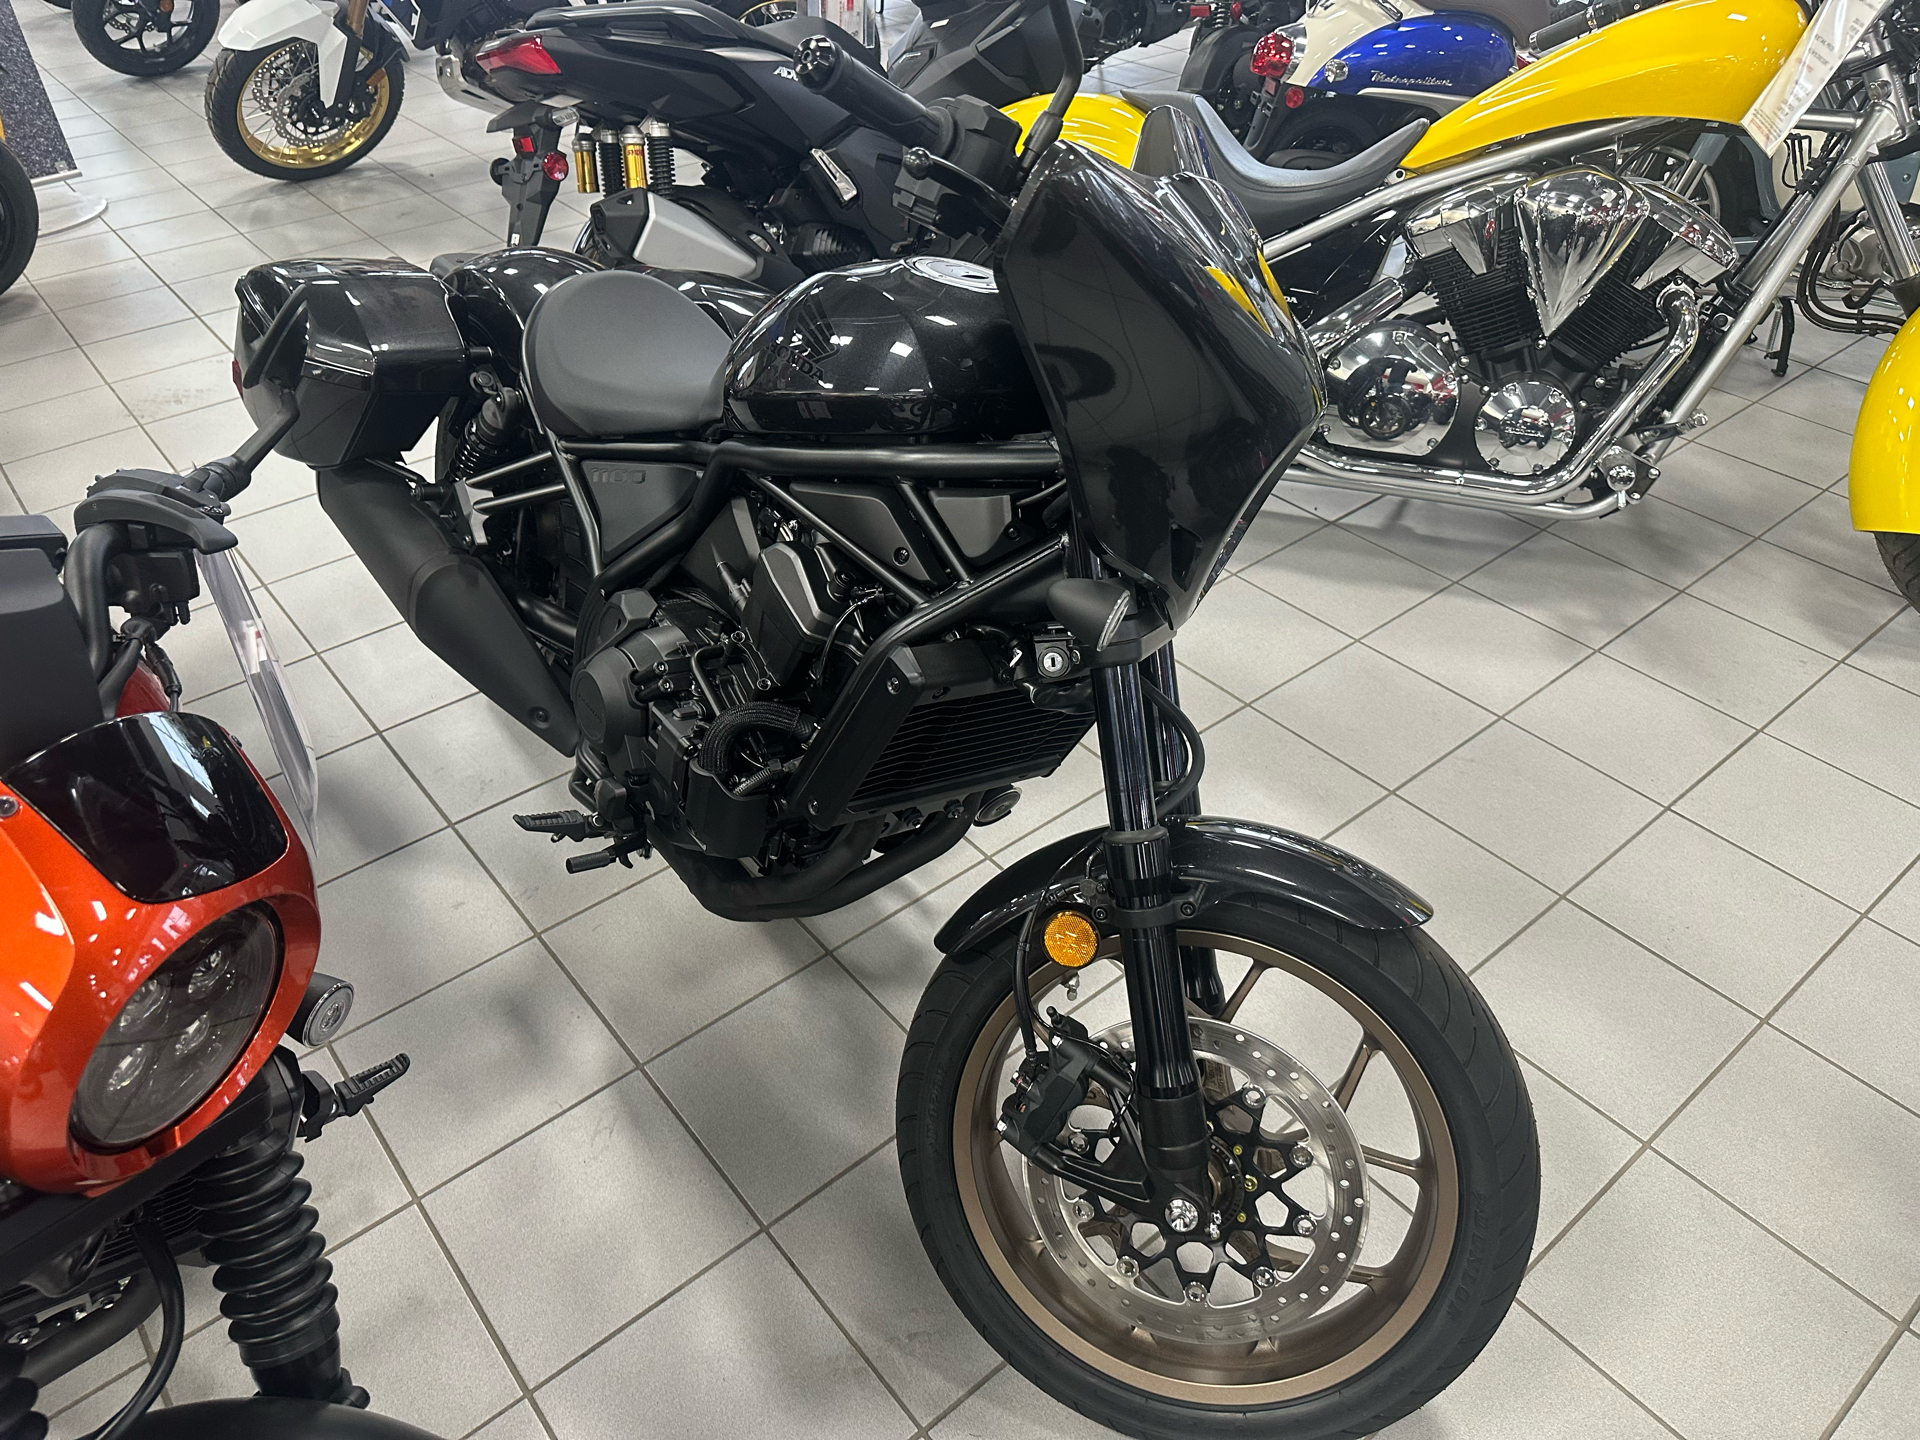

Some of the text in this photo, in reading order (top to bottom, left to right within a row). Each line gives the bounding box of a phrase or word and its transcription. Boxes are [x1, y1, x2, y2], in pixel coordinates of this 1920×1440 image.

[1371, 69, 1453, 87] Metropolitan
[768, 341, 826, 384] HONDA
[591, 467, 647, 485] 1100
